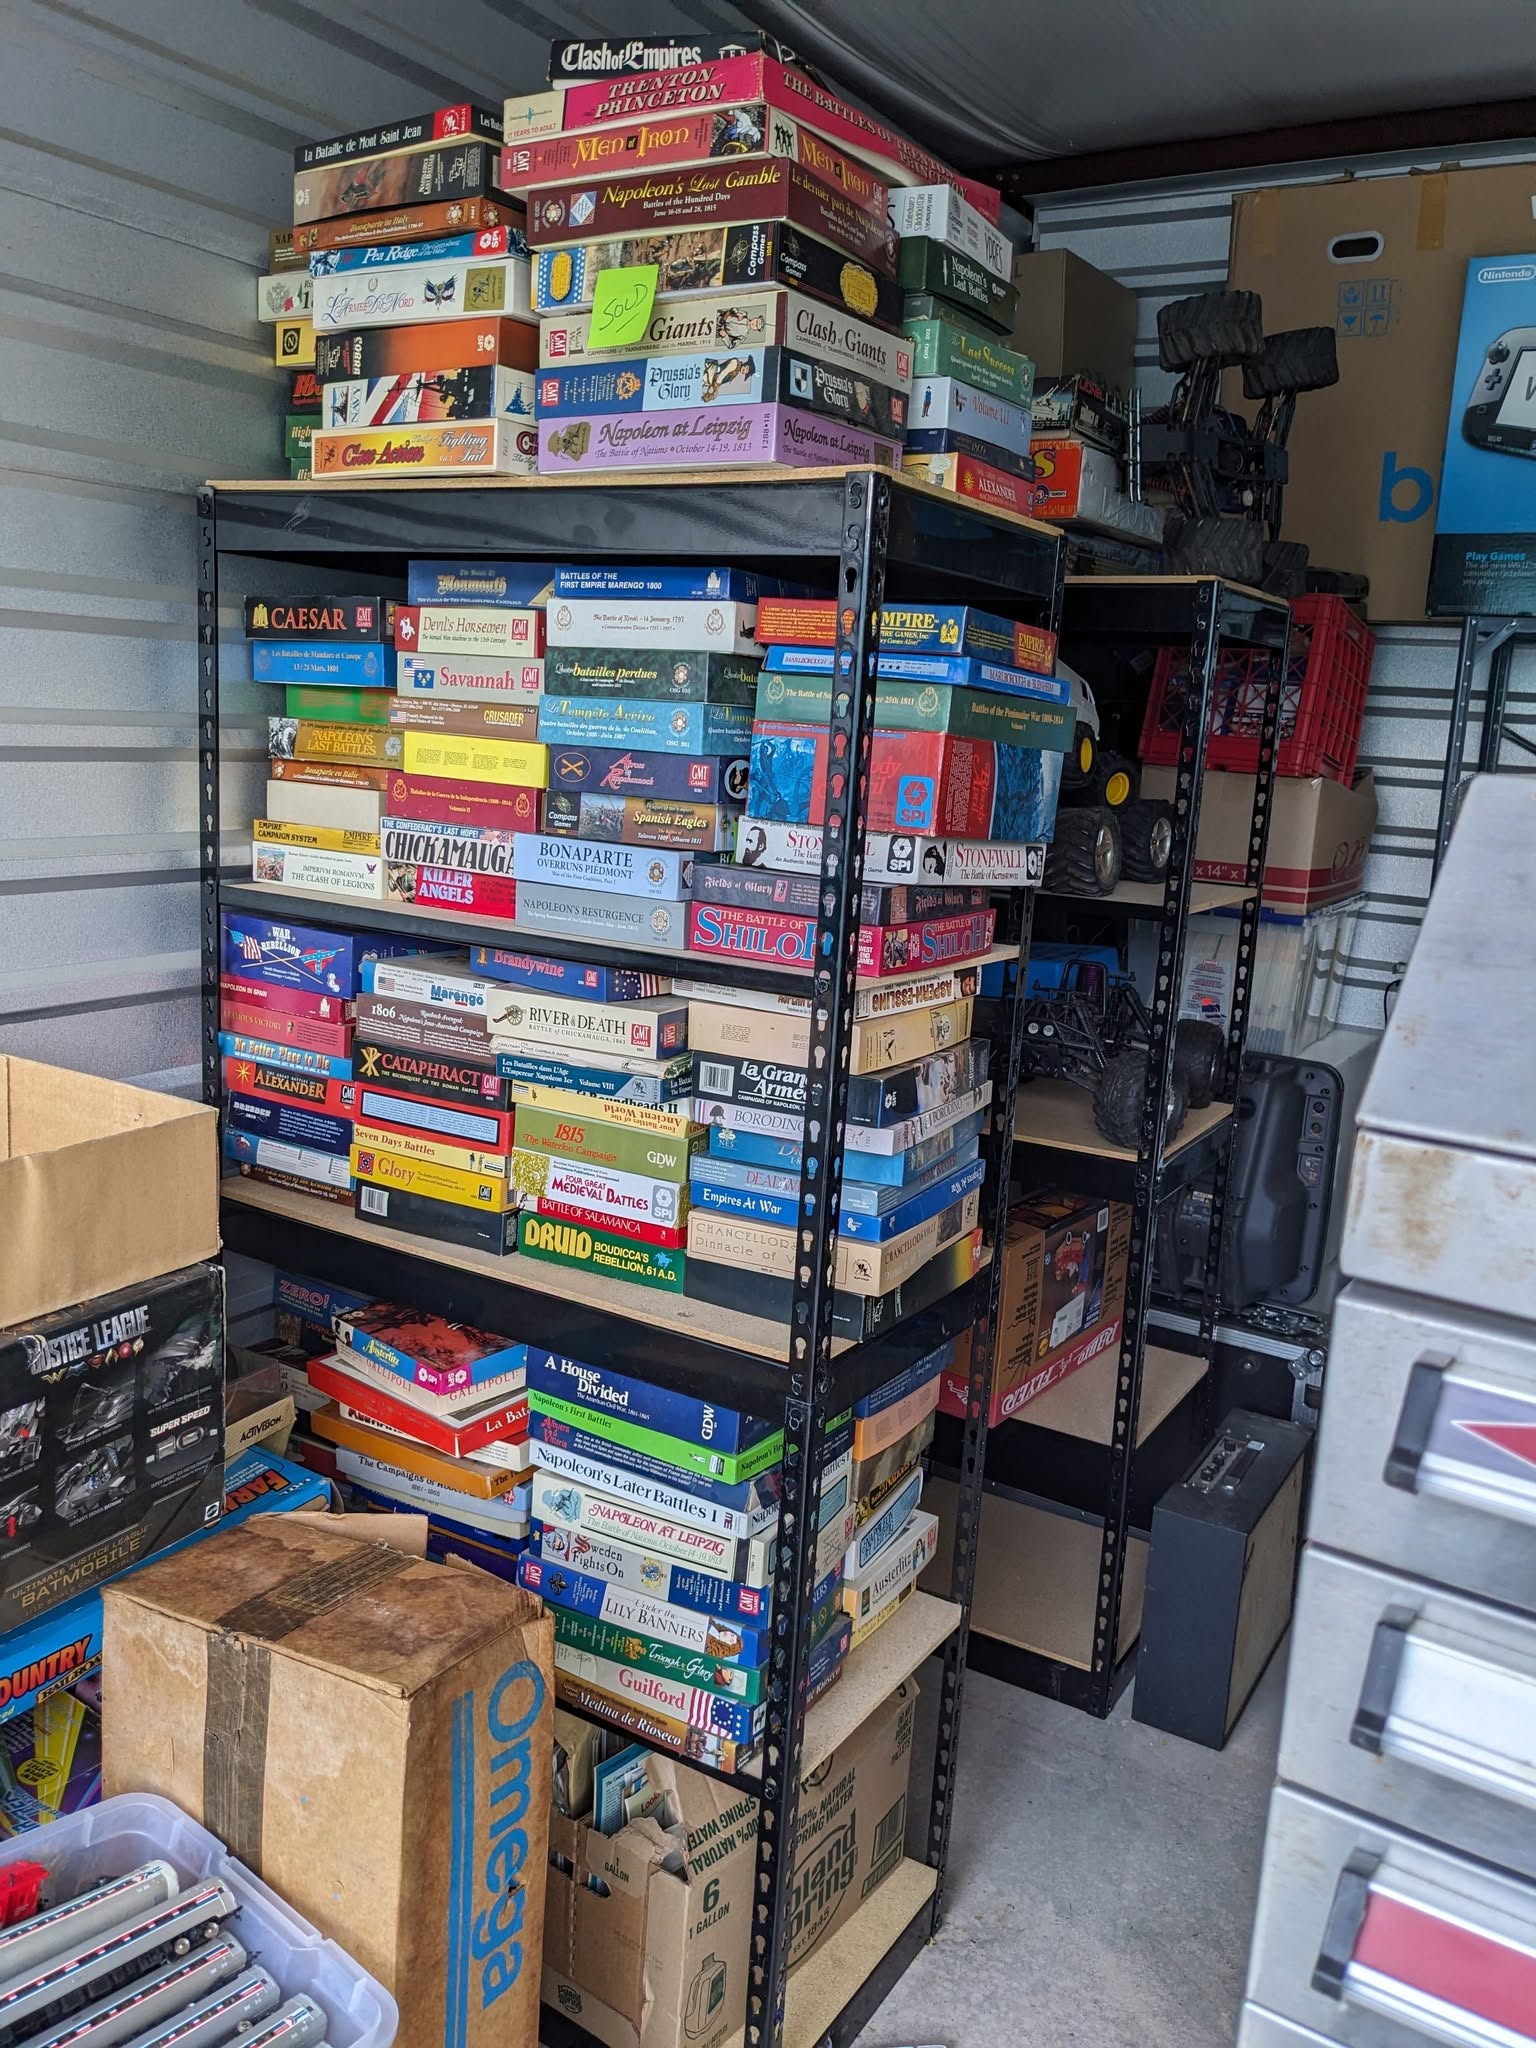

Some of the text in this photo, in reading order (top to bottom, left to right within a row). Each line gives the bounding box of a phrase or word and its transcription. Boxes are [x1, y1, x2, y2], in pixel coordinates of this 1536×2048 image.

[608, 66, 717, 99] TRENTON
[594, 83, 726, 120] PRINCETON
[304, 124, 422, 162] La Bataille de Mont Saint Jean
[513, 128, 531, 137] YEARS
[541, 123, 557, 133] ADULT
[601, 164, 782, 209] Napoleon's Last Gamble
[361, 248, 384, 264] Pea
[384, 245, 419, 264] Ridge
[748, 225, 760, 276] Compass
[951, 255, 988, 289] Napoleon's
[1482, 270, 1532, 281] Nintendo
[649, 316, 714, 342] Giants
[650, 363, 702, 387] Prussia's
[814, 365, 854, 395] Prussia's
[351, 384, 361, 424] NAVY
[658, 381, 692, 402] Glory
[598, 415, 753, 448] Napoleon at Leipzig
[594, 449, 607, 459] The
[608, 447, 630, 458] Battle
[631, 447, 639, 459] of
[640, 446, 668, 457] Nations
[675, 443, 706, 454] October
[730, 441, 752, 452] 1813
[978, 477, 1018, 502] ALEXANDER
[1491, 552, 1527, 561] Games
[560, 572, 618, 580] BATTLES OF THE
[560, 581, 663, 590] FIRST EMPIRE MARENGO 1800
[271, 607, 347, 630] CAESAR
[357, 608, 372, 621] GMT
[423, 616, 507, 634] Devil's Horsemen
[440, 666, 515, 690] Savannah
[307, 740, 377, 756] LAST BATTLES
[258, 821, 282, 831] EMPIRE
[384, 819, 479, 838] THE CONFEDERACY'S LAST HOPE!
[548, 811, 578, 822] Compass
[554, 820, 572, 828] Games
[633, 810, 707, 830] Spanish Eagles
[900, 809, 927, 824] SPI
[258, 830, 318, 845] CAMPAIGN SYSTEM
[343, 830, 372, 842] EMPIRE
[539, 841, 633, 868] BONAPARTE
[889, 859, 911, 872] SPI
[954, 842, 1026, 869] STONEWALL
[291, 871, 376, 891] THE CLASH OF LEGIONS
[332, 868, 365, 880] ROMANVM
[422, 866, 474, 888] KILLER
[418, 882, 475, 905] ANGELS
[523, 898, 581, 916] NAPOLEON'S
[582, 906, 644, 924] RESURGENCE
[721, 910, 804, 931] THE BATTLE OF
[271, 926, 291, 941] WAR
[921, 914, 986, 964] SHILOH
[260, 939, 301, 959] REBELLION
[493, 949, 565, 979] Brandywine
[430, 984, 484, 1007] Marengo
[871, 977, 953, 1014] ASPERN-ESSLING
[371, 1003, 396, 1019] 1806
[528, 1007, 627, 1037] RIVER DEATH
[381, 1053, 481, 1087] CATAPHRACT
[255, 1072, 327, 1100] ALEXANDER
[355, 1128, 436, 1157] Seven Days Battles
[554, 1123, 586, 1144] 1815
[718, 1139, 736, 1148] NES
[522, 1133, 617, 1162] The Waterloo Campaign
[647, 1150, 677, 1167] GDW
[378, 1157, 416, 1187] Glory
[565, 1174, 606, 1190] FOUR GREAT
[551, 1176, 649, 1211] MEDIEVAL BATTLES
[541, 1199, 641, 1234] BATTLE OF SALAMANCA
[653, 1208, 672, 1220] SPI
[524, 1218, 593, 1260] DRUID
[696, 1237, 777, 1262] Pinnacle of
[594, 1241, 649, 1264] BOUDICCA'S
[279, 1280, 330, 1309] ZERO!
[366, 1358, 412, 1392] GALLIPOLI
[427, 1373, 438, 1385] SPI
[544, 1355, 601, 1384] A House
[576, 1378, 629, 1407] Divided
[150, 1405, 211, 1438] SUPER SPEED
[701, 1404, 715, 1440] GDW
[358, 1455, 425, 1484] The Campaigns
[537, 1446, 612, 1486] Napoleon's
[613, 1475, 652, 1500] Later
[653, 1488, 708, 1521] Battles
[711, 1510, 718, 1522] I
[588, 1503, 726, 1557] NAPOLEON AT LEIPZIG
[571, 1533, 624, 1563] Sweden
[21, 1537, 143, 1609] BATMOBILE
[872, 1551, 913, 1599] Austerlitz
[604, 1597, 706, 1644] LILY BANNERS
[618, 1667, 687, 1711] Guilford
[577, 1690, 682, 1747] Medina de Rioseco
[819, 1766, 857, 1814] NATURAL
[471, 1658, 547, 2011] Omega
[688, 1835, 737, 1876] NATURAL
[604, 1862, 630, 1884] GALLON
[703, 1877, 720, 1914] 6
[806, 1905, 831, 1940] 1845
